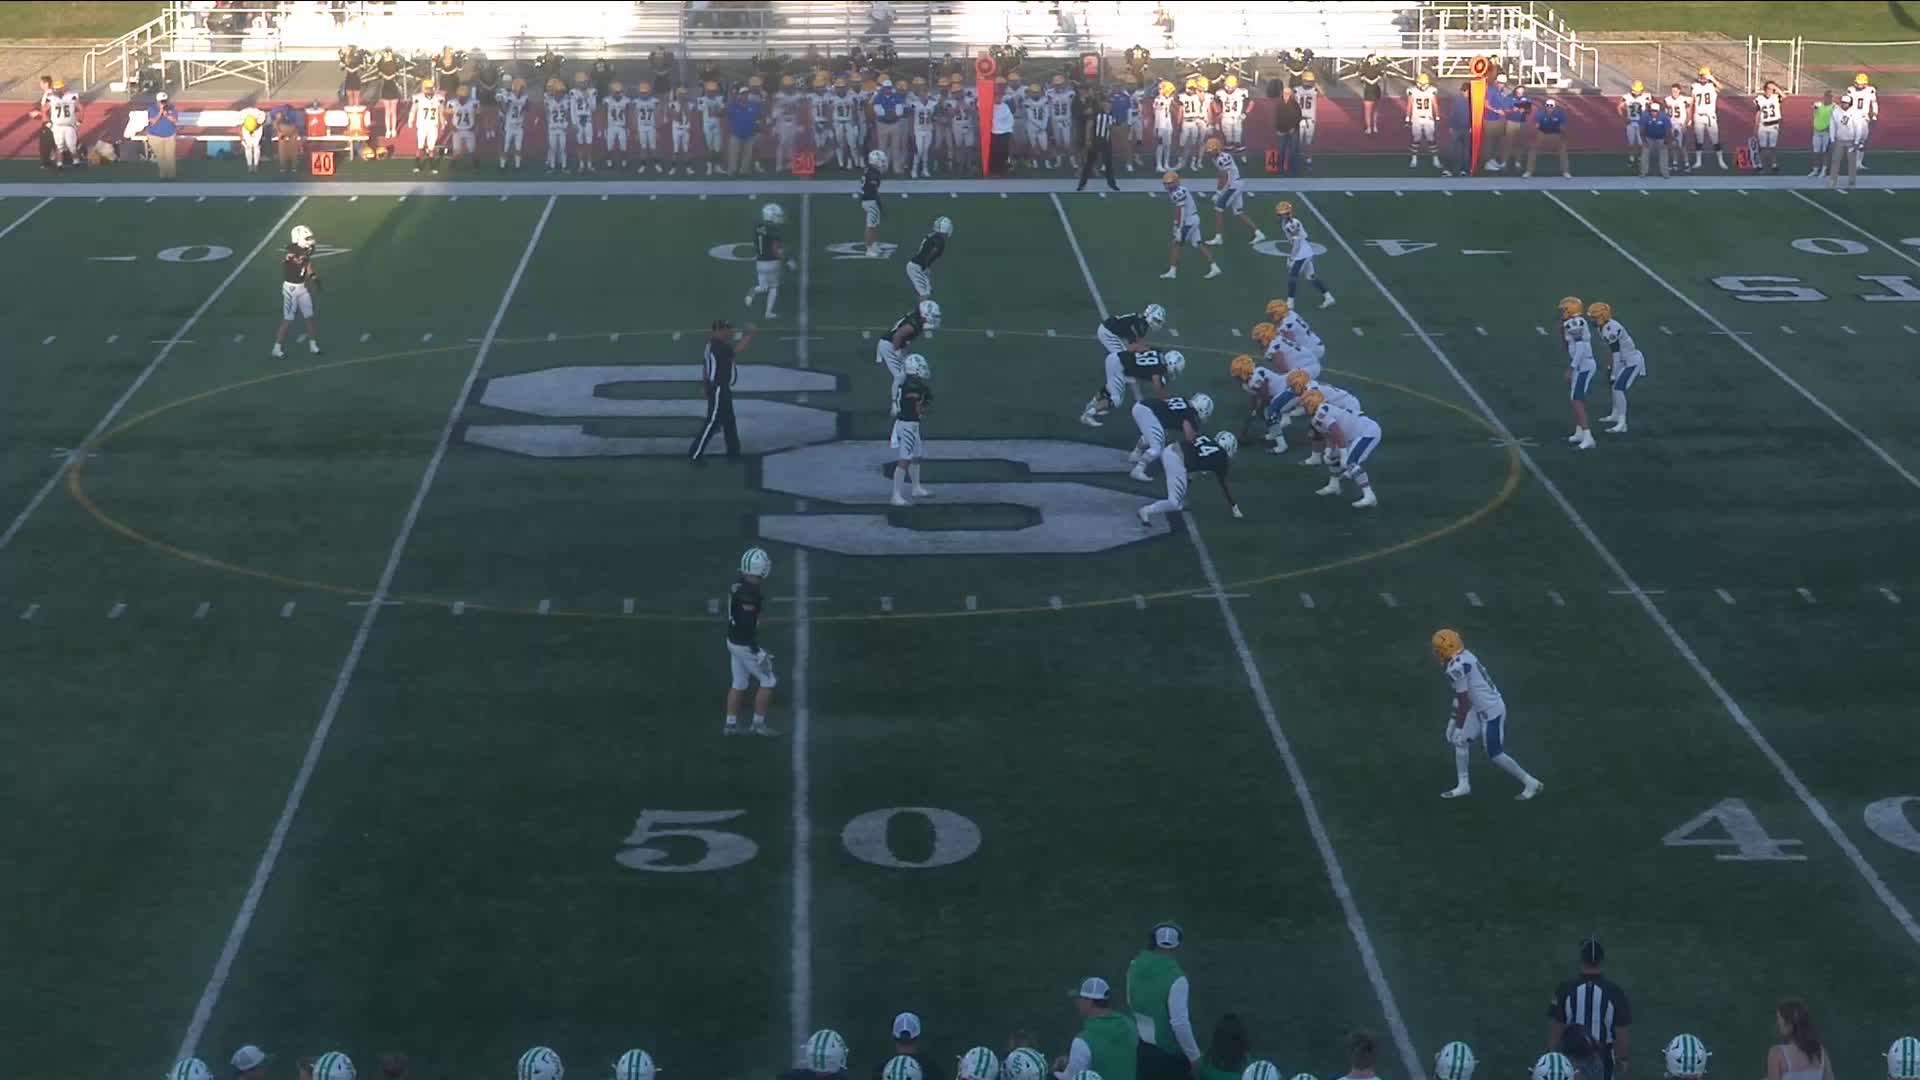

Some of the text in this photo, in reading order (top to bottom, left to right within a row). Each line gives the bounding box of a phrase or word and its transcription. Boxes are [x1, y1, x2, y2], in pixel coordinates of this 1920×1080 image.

[1697, 92, 1711, 107] 78
[54, 103, 71, 119] 76
[423, 107, 437, 121] 73
[1184, 101, 1196, 114] 21
[1225, 102, 1238, 114] 54
[457, 111, 471, 125] 74
[313, 154, 332, 173] 40
[1135, 350, 1159, 366] 58
[1193, 435, 1220, 457] 54
